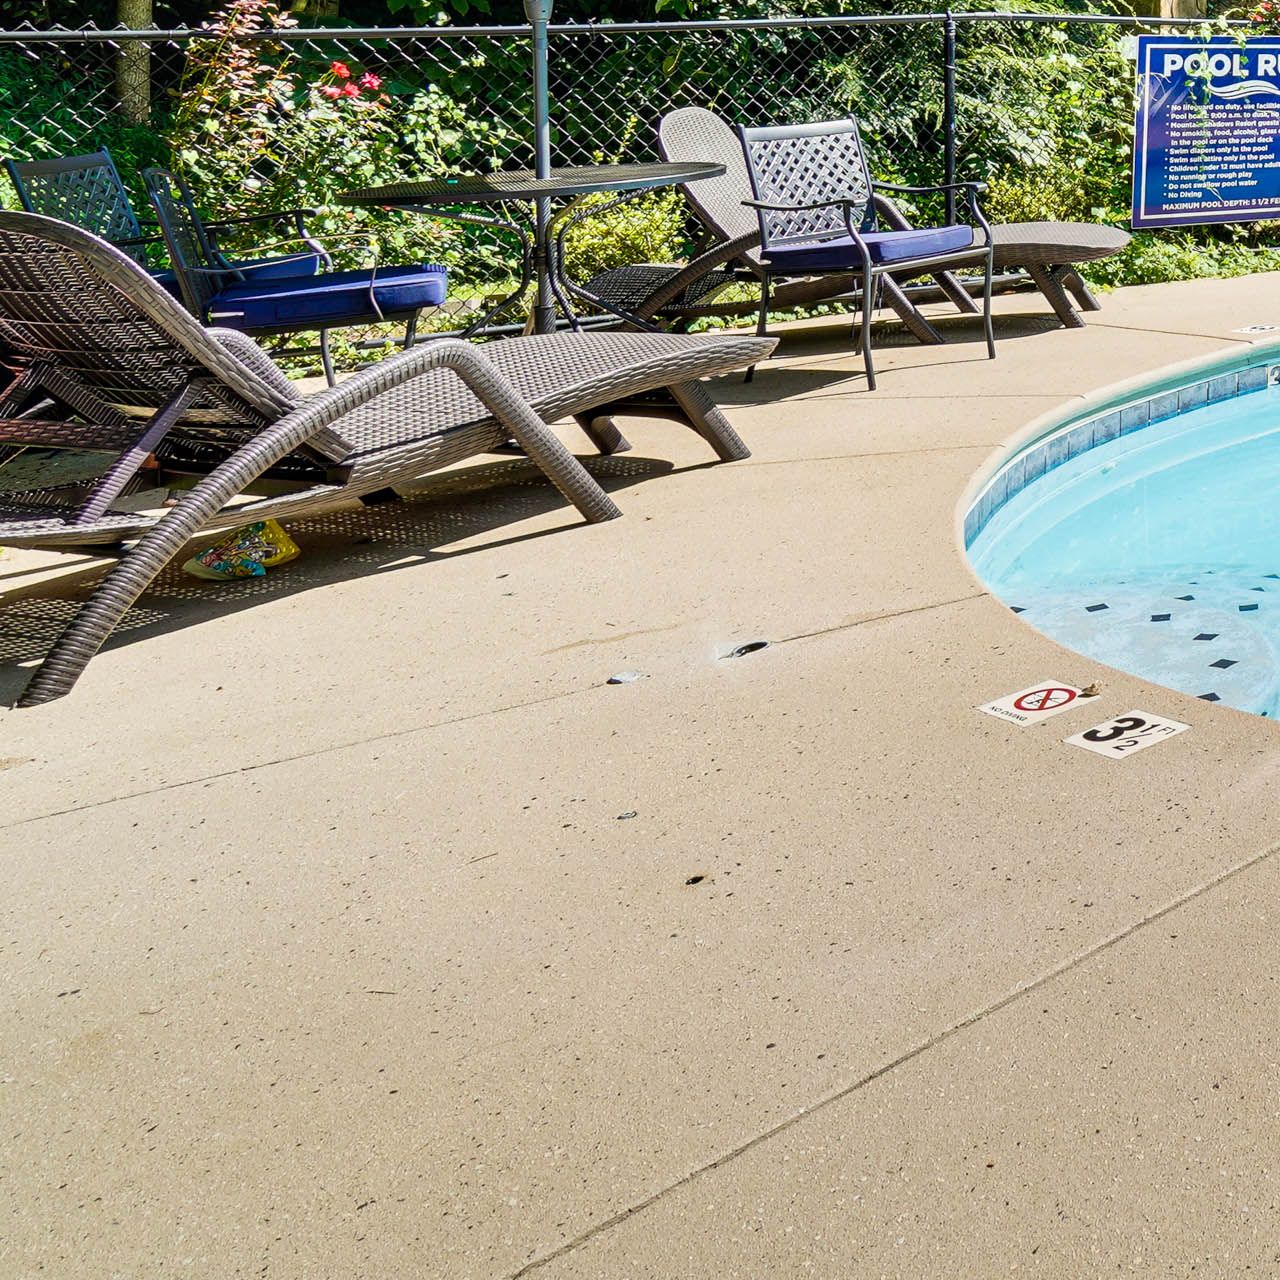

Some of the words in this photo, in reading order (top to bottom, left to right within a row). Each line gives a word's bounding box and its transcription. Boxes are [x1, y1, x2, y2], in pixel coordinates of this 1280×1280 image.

[1163, 53, 1250, 78] POOL
[1225, 103, 1243, 111] duty,
[1170, 112, 1187, 120] Pool
[1228, 111, 1243, 119] a.m.
[1203, 120, 1234, 128] Shadows
[1257, 119, 1280, 127] guests
[1213, 129, 1232, 137] food,
[1232, 128, 1260, 136] alcohol,
[1260, 128, 1278, 136] glass
[1179, 138, 1191, 146] the
[1192, 139, 1208, 147] pool
[1240, 137, 1257, 145] pool
[1257, 135, 1274, 143] deck
[1169, 147, 1189, 155] Swim
[1190, 147, 1216, 155] diapers
[1216, 146, 1232, 154] only
[1232, 144, 1240, 152] in
[1252, 144, 1269, 152] pool
[1169, 156, 1189, 164] Swim
[1189, 155, 1202, 163] suit
[1222, 154, 1239, 162] only
[1239, 153, 1247, 161] in
[1247, 152, 1259, 160] the
[1259, 152, 1275, 160] pool
[1168, 165, 1199, 173] Children
[1199, 164, 1220, 172] nder
[1229, 162, 1247, 170] must
[1246, 162, 1264, 170] have
[1168, 173, 1180, 181] No
[1180, 172, 1207, 181] running
[1216, 171, 1238, 179] rough
[1237, 170, 1253, 179] play
[1168, 182, 1180, 190] Do
[1179, 181, 1193, 189] not
[1193, 180, 1221, 188] swallow
[1221, 179, 1239, 188] pool
[1238, 178, 1258, 186] water
[1168, 191, 1179, 199] No
[1179, 190, 1203, 199] Diving
[1162, 203, 1201, 211] MAXIMUM
[1201, 201, 1223, 209] POOL
[1223, 200, 1252, 208] DEPTH:
[1257, 198, 1270, 206] 1/2
[1082, 716, 1147, 743] 3
